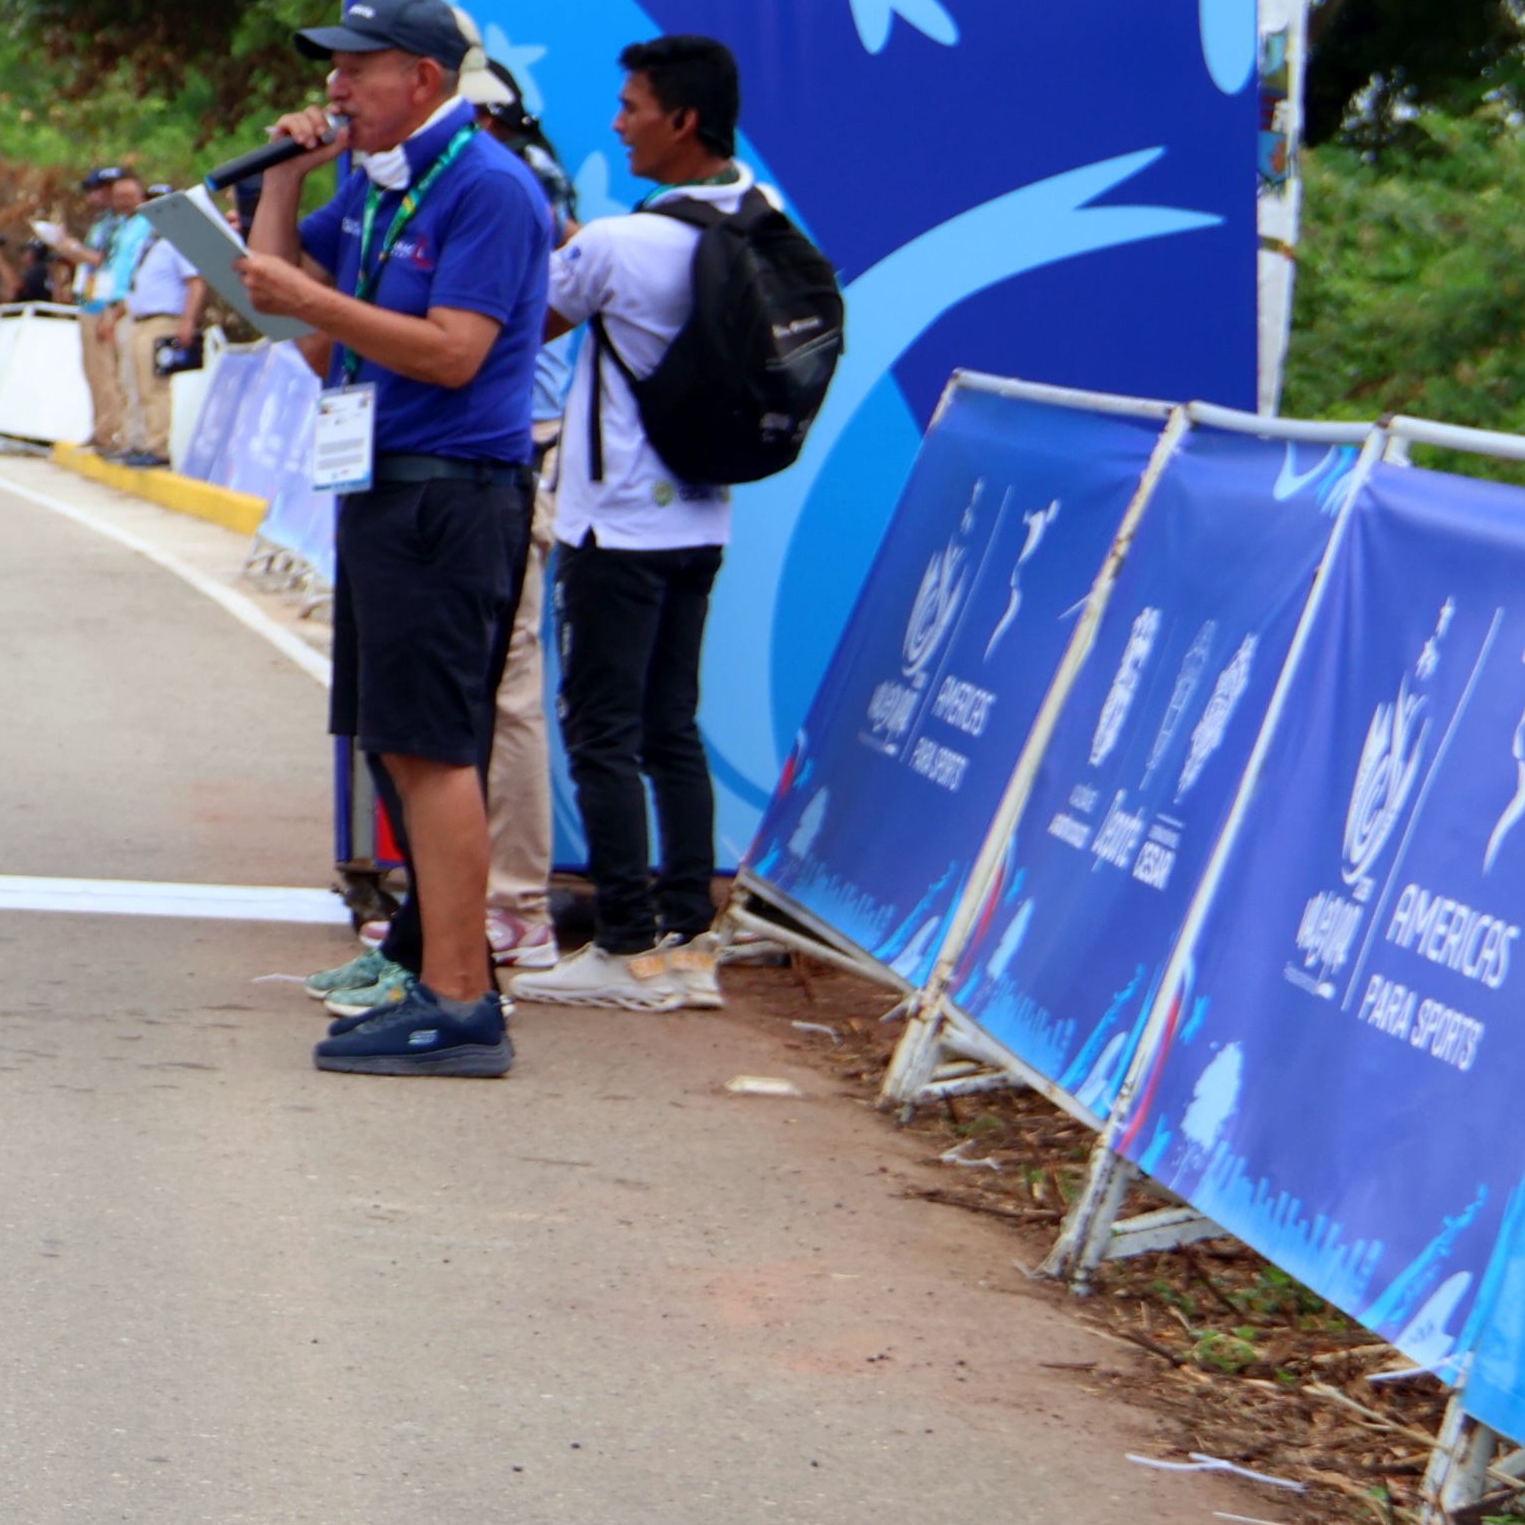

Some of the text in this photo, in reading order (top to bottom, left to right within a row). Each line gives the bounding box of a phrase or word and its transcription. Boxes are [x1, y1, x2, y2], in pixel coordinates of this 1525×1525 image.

[1386, 883, 1522, 989] AMERICAS
[1357, 975, 1418, 1040] PARA
[1410, 999, 1485, 1072] SPORTS
